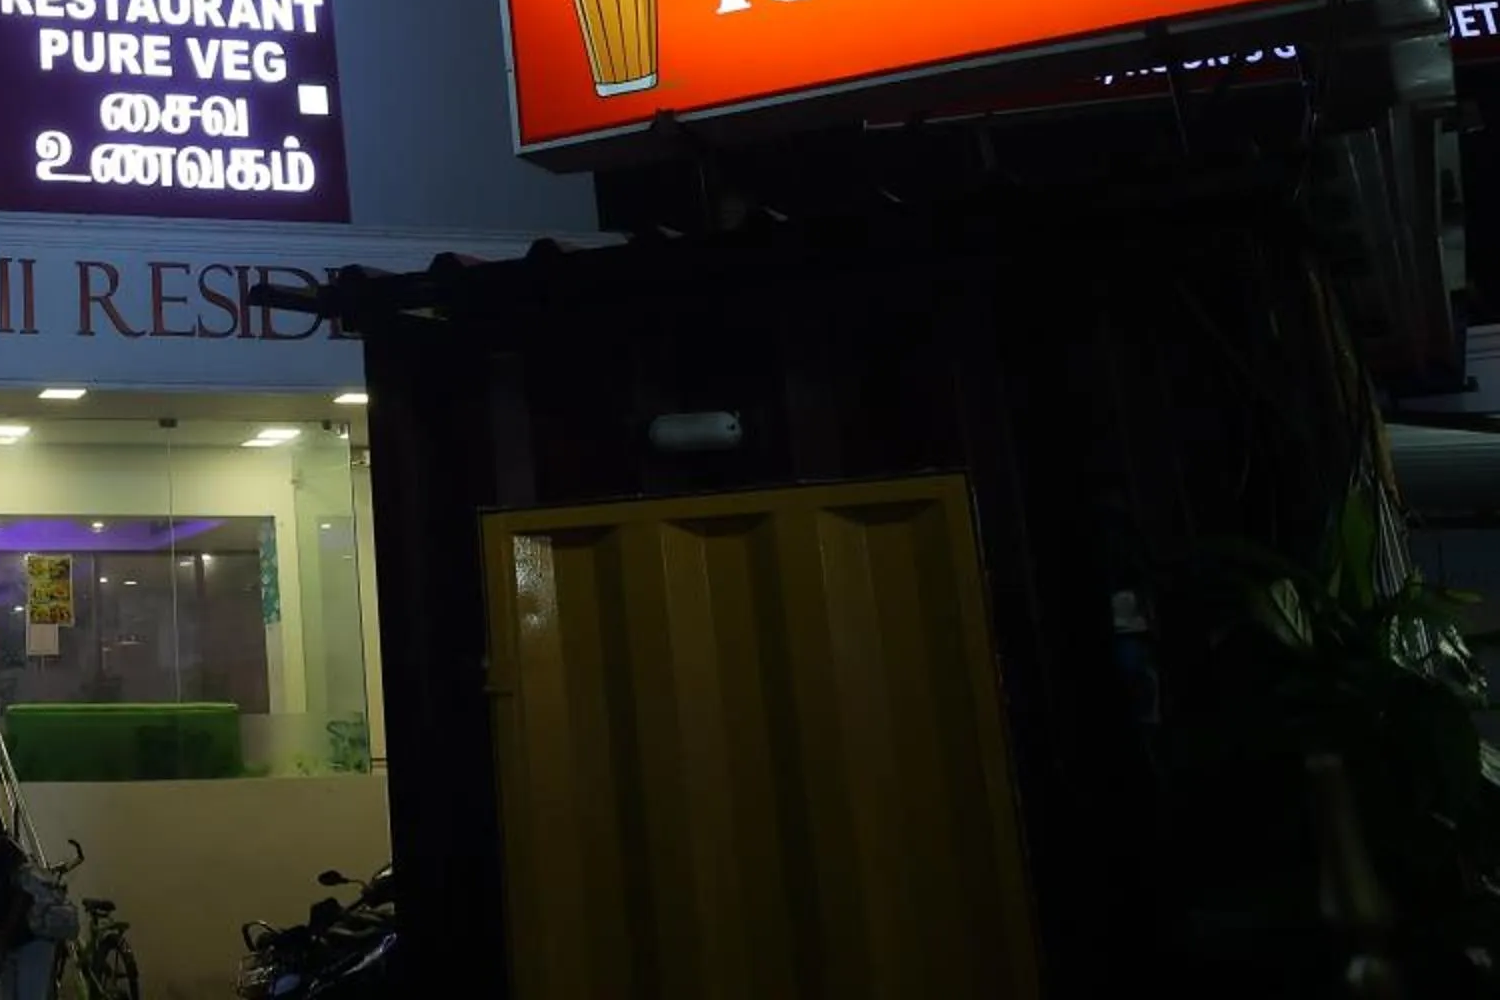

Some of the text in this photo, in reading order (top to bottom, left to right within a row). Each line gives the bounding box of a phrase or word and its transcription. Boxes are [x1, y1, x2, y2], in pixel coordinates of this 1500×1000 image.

[39, 28, 287, 83] PURE VEG
[100, 92, 249, 137] சைவ
[35, 130, 315, 192] உணவகம்
